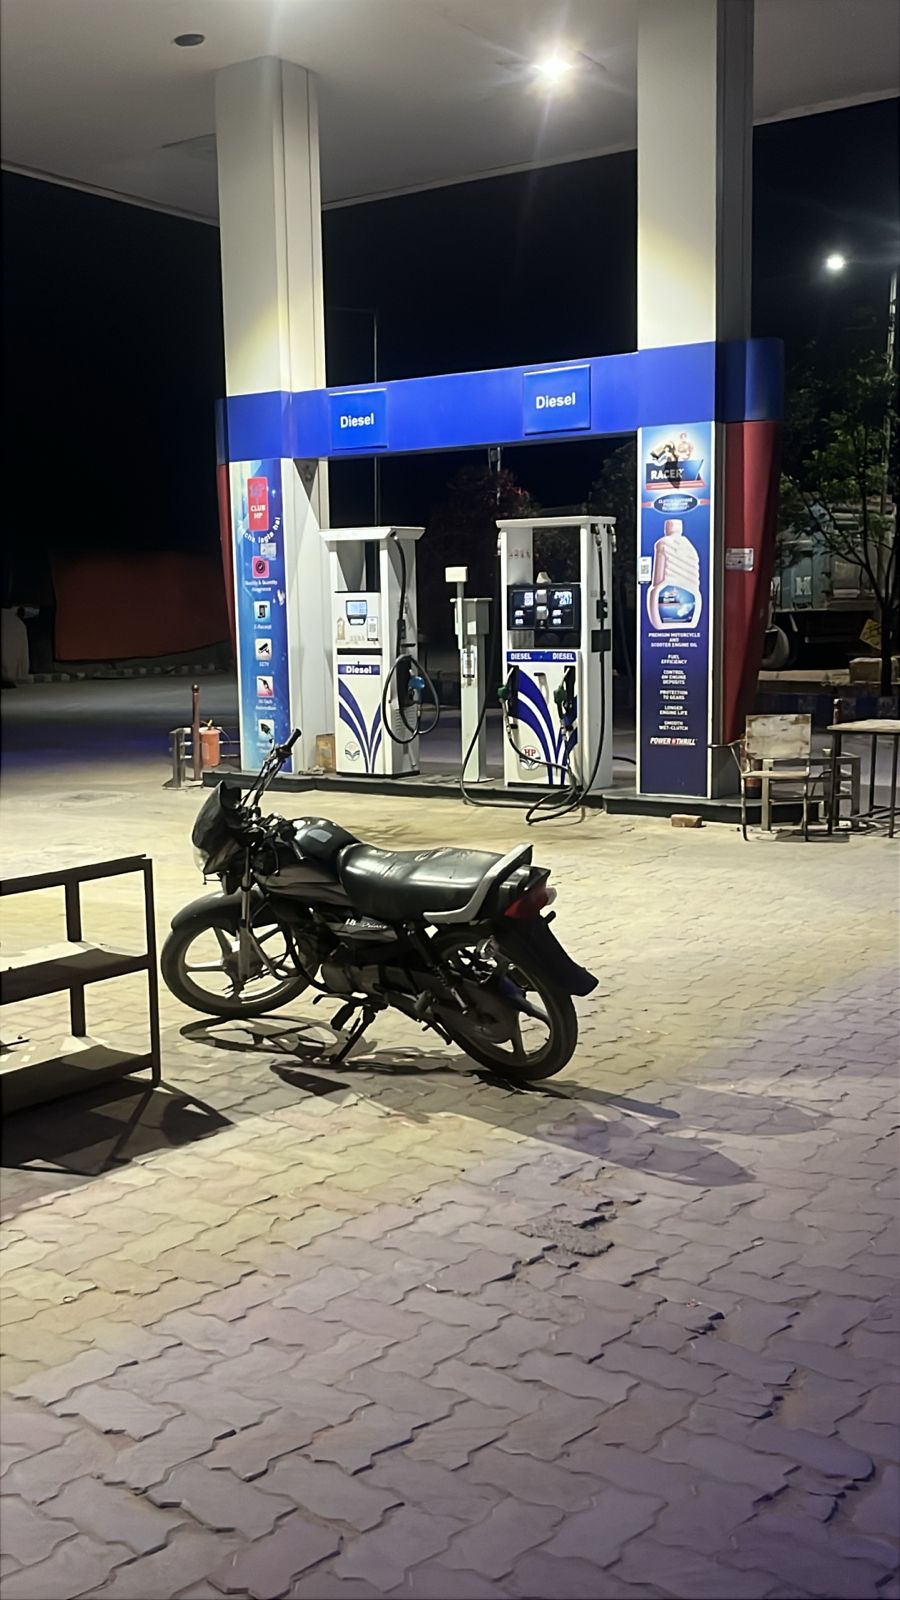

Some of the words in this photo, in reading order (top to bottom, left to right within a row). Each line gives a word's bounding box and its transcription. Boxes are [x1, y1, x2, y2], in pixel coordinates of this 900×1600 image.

[536, 392, 576, 409] Diesel
[340, 412, 374, 428] Diesel
[650, 468, 682, 480] RACER
